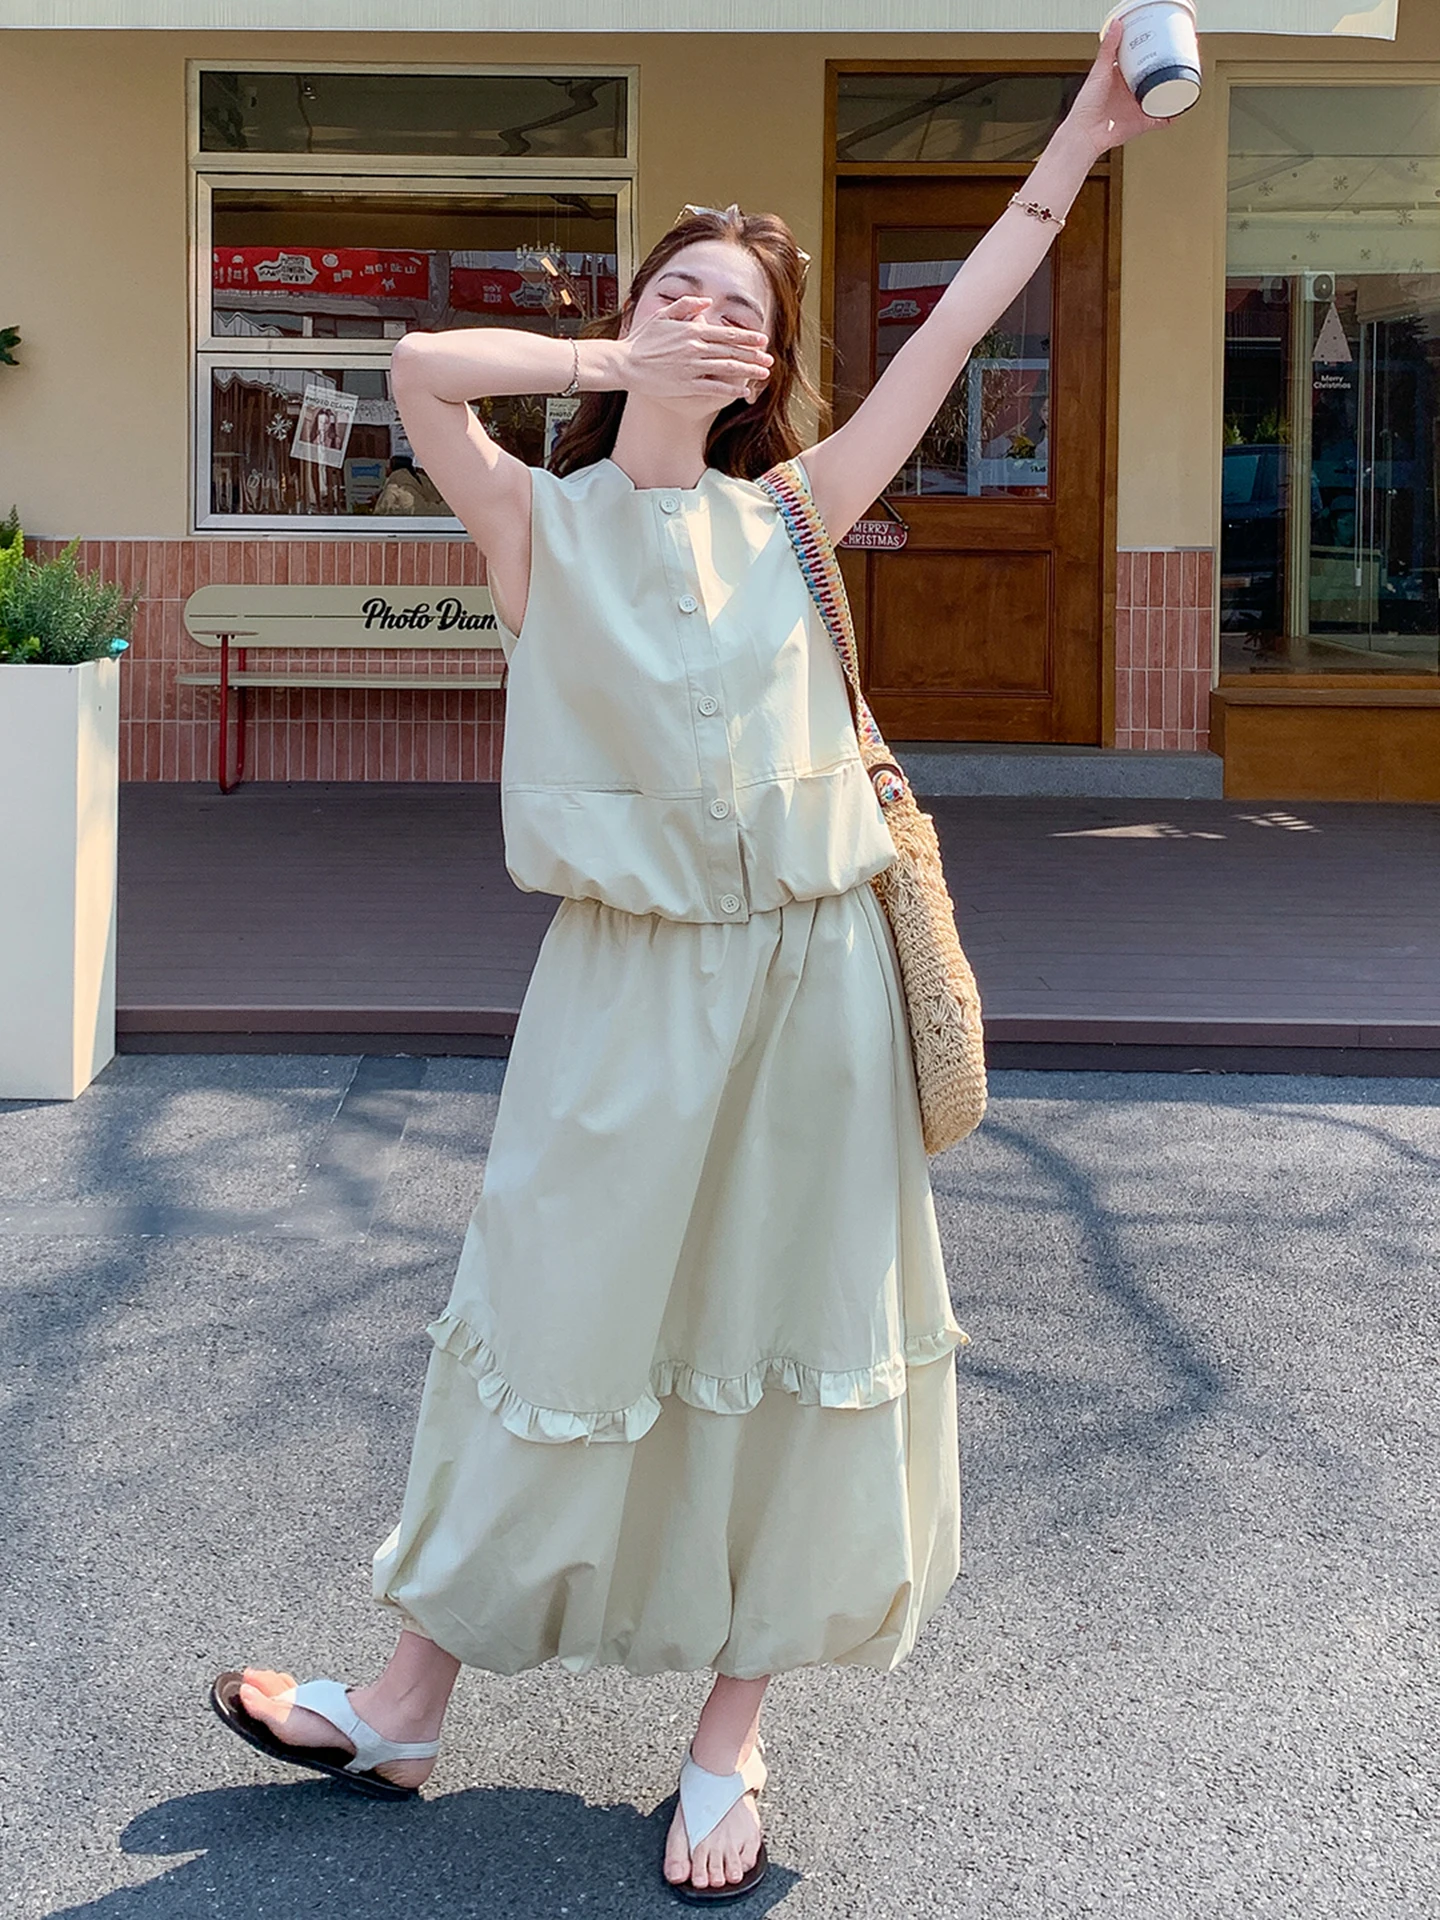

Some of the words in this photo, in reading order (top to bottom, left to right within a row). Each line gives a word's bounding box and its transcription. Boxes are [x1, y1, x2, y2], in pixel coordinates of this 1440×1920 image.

[1320, 375, 1344, 383] Merry
[1313, 381, 1351, 389] Christmas
[853, 523, 889, 535] MERRY
[362, 597, 434, 630] Photo
